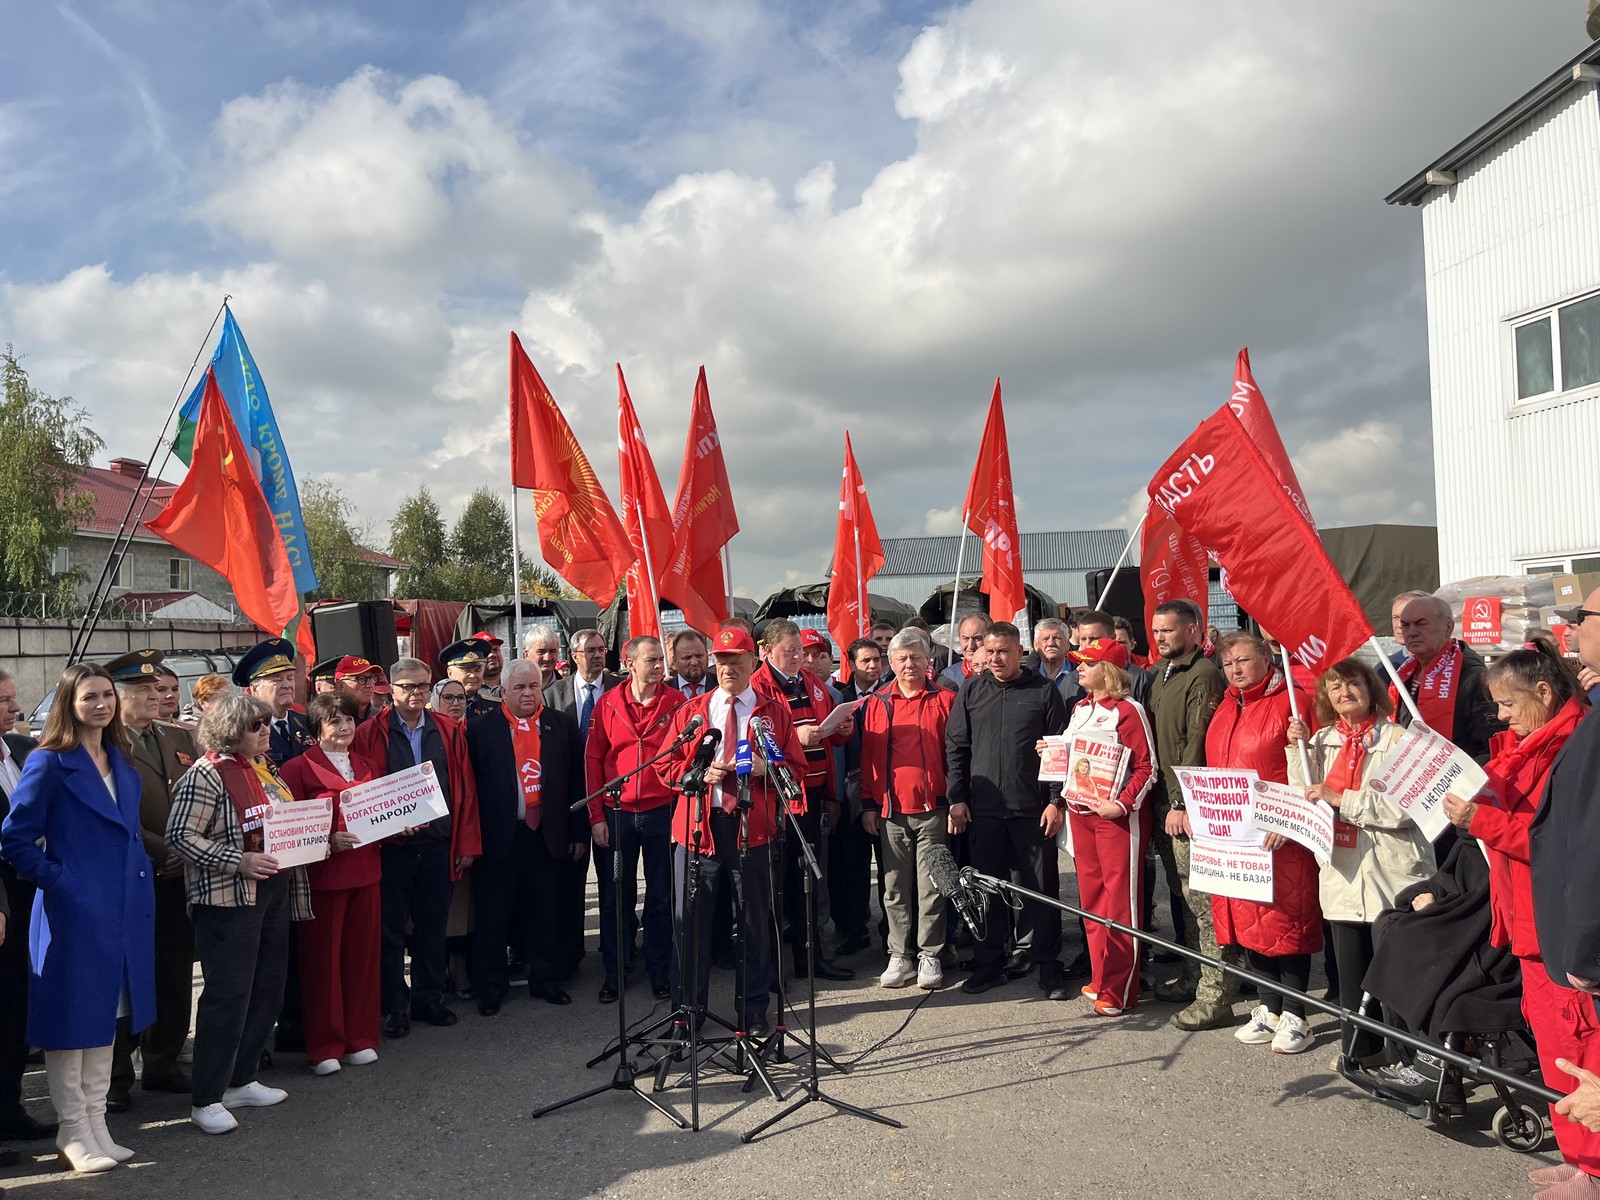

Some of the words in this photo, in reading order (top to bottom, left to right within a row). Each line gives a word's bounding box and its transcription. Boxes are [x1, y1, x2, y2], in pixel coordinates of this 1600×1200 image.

[258, 423, 288, 504] КРОМЕ
[274, 510, 301, 568] НАС!
[1470, 621, 1492, 630] КПРФ
[1193, 775, 1208, 788] МЫ
[1208, 776, 1249, 789] ПРОТИВ
[1399, 762, 1440, 809] СПРАВЕДЛИВЫЕ
[1432, 762, 1464, 796] ПОДАЧКИ
[346, 799, 397, 822] БОГАТСТВА
[397, 784, 435, 804] РОССИИ
[1191, 789, 1250, 805] АГРЕССИВНОЙ
[1424, 791, 1438, 807] НЕ
[370, 802, 418, 826] НАРОДУ
[1199, 805, 1243, 821] ПОЛИТИКИ
[1255, 801, 1305, 823] ГОРОДАМ
[1307, 818, 1313, 827] И
[1421, 800, 1431, 812] А
[242, 816, 262, 833] ВОЙ
[269, 826, 304, 839] ОСТАНОВИМ
[304, 823, 320, 834] РОСТ
[1208, 822, 1231, 837] США!
[1254, 812, 1289, 829] РАБОЧИЕ
[1290, 822, 1311, 839] МЕСТА
[1311, 833, 1316, 842] И
[270, 840, 296, 854] ДОЛГОВ
[296, 839, 301, 847] И
[1192, 852, 1222, 867] ЗДОРОВЬЕ
[1227, 859, 1238, 869] НЕ
[1240, 861, 1271, 873] ТОВАР,
[1191, 864, 1225, 879] МЕДИЦИНА
[1230, 871, 1241, 881] НЕ
[1243, 873, 1272, 884] БАЗАР
